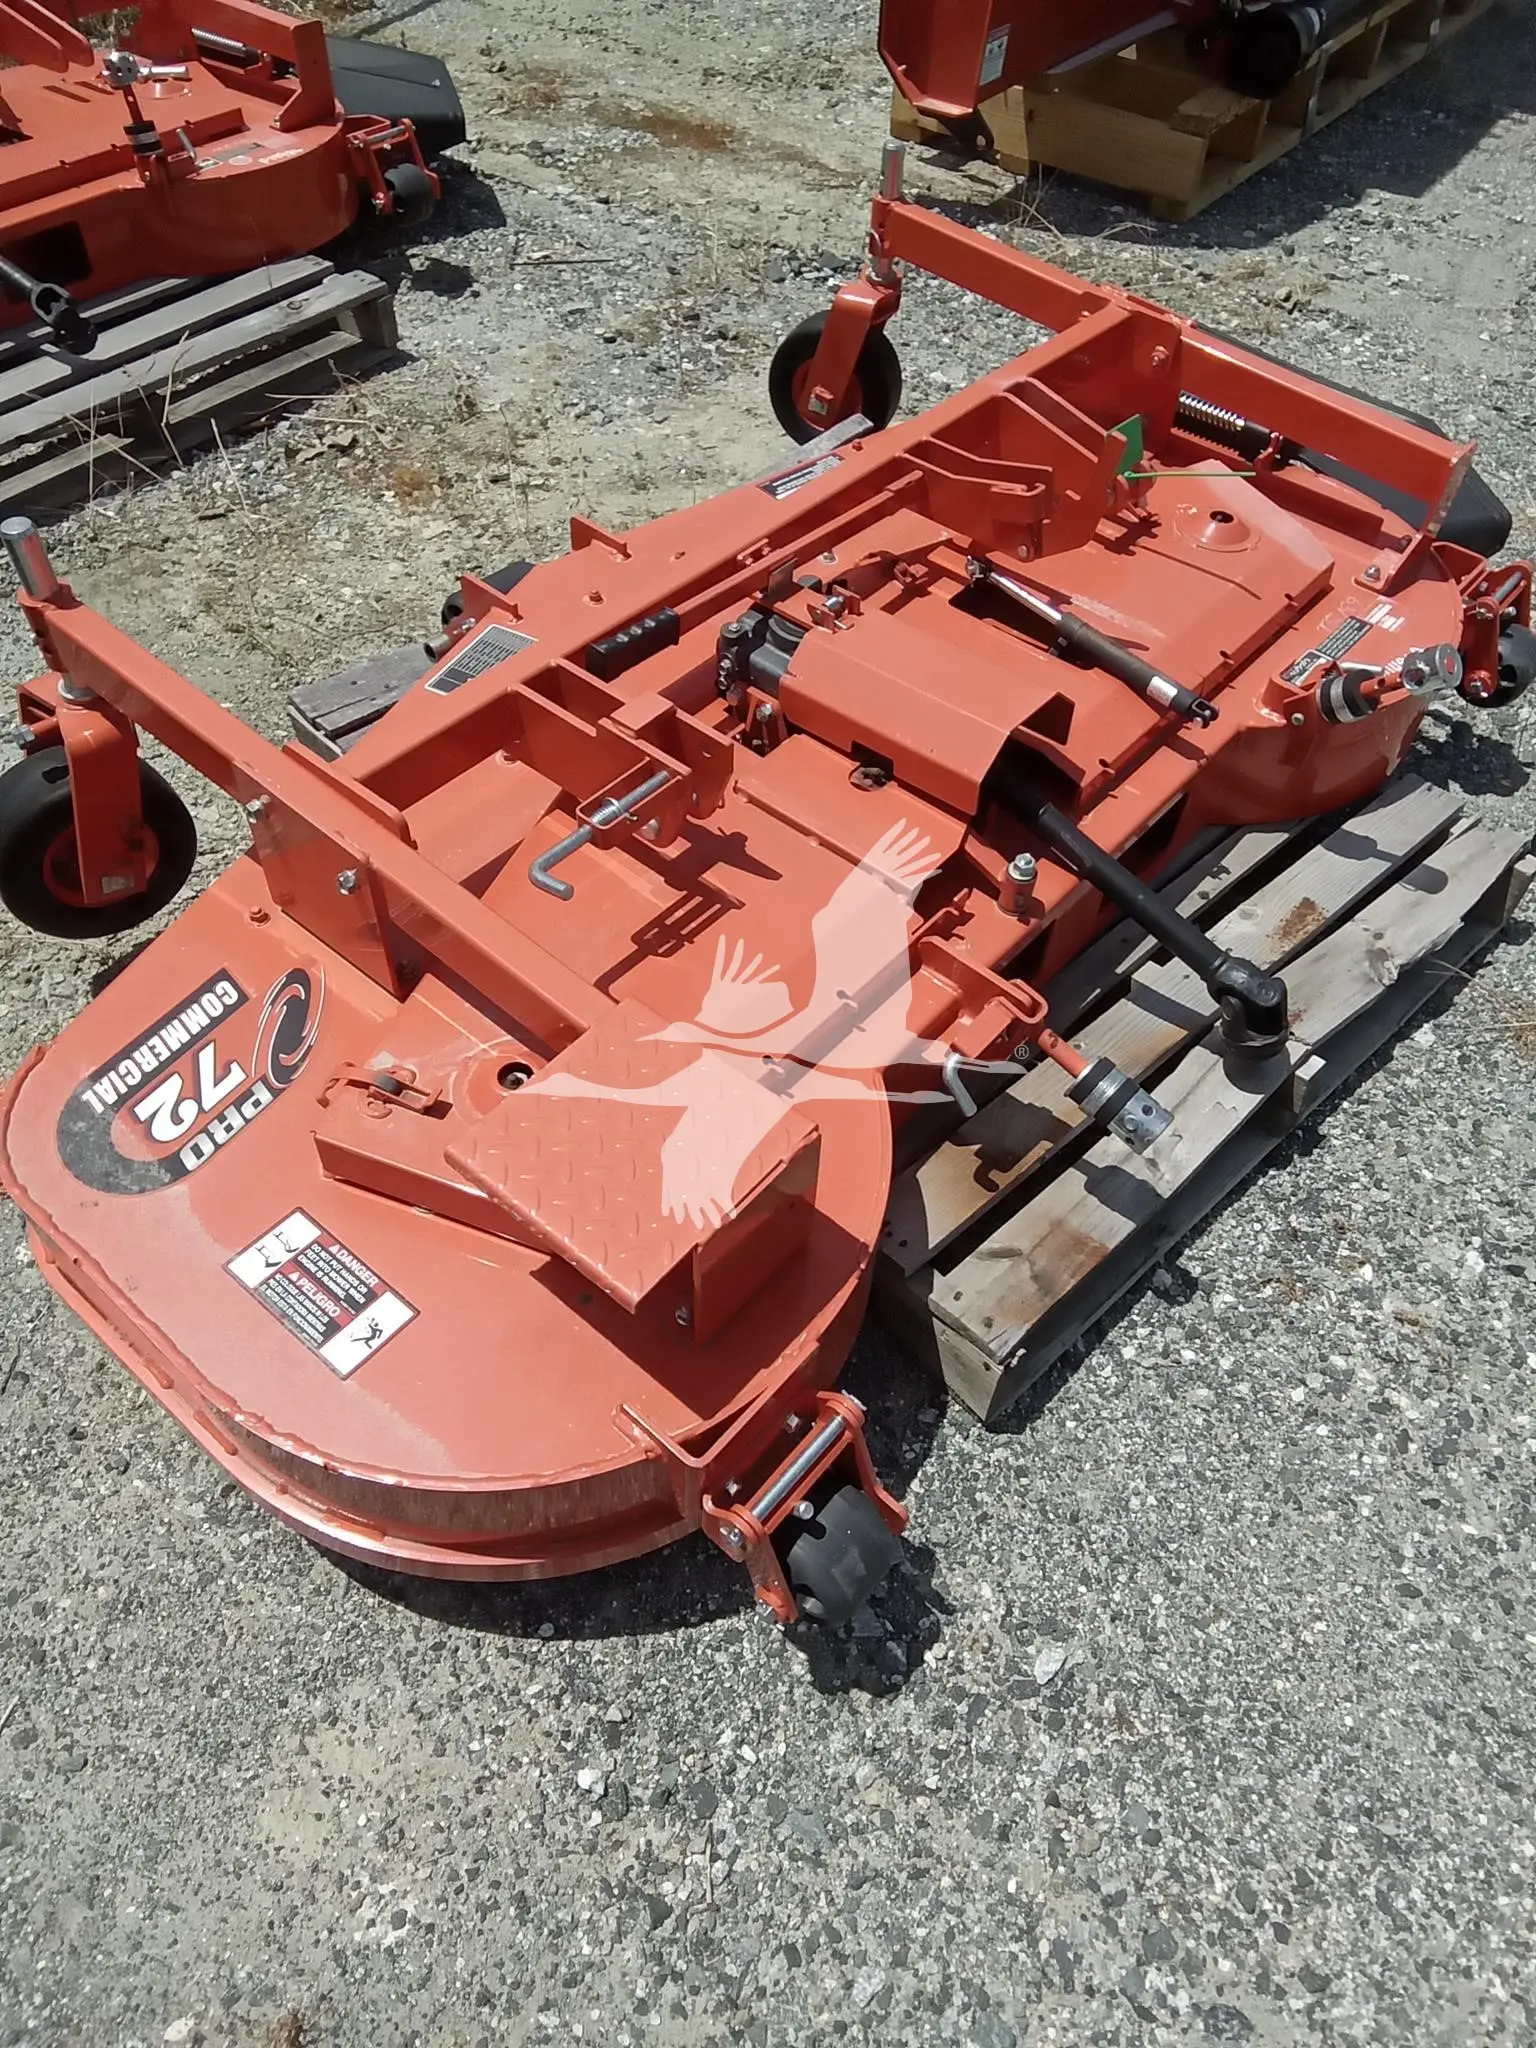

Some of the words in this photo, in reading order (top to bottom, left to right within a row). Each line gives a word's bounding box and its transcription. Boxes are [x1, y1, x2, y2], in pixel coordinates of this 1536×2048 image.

[80, 980, 239, 1114] COMMERCIAL
[133, 1040, 248, 1142] 72
[179, 1079, 274, 1172] PRO
[303, 1248, 319, 1262] FEET
[316, 1259, 331, 1273] INTO
[328, 1270, 350, 1290] MOWER
[310, 1243, 321, 1252] DO
[318, 1250, 332, 1262] NOT
[329, 1259, 342, 1271] PUT
[339, 1268, 359, 1286] HANDS
[335, 1248, 379, 1287] DANGER
[295, 1276, 341, 1318] PELIGRO
